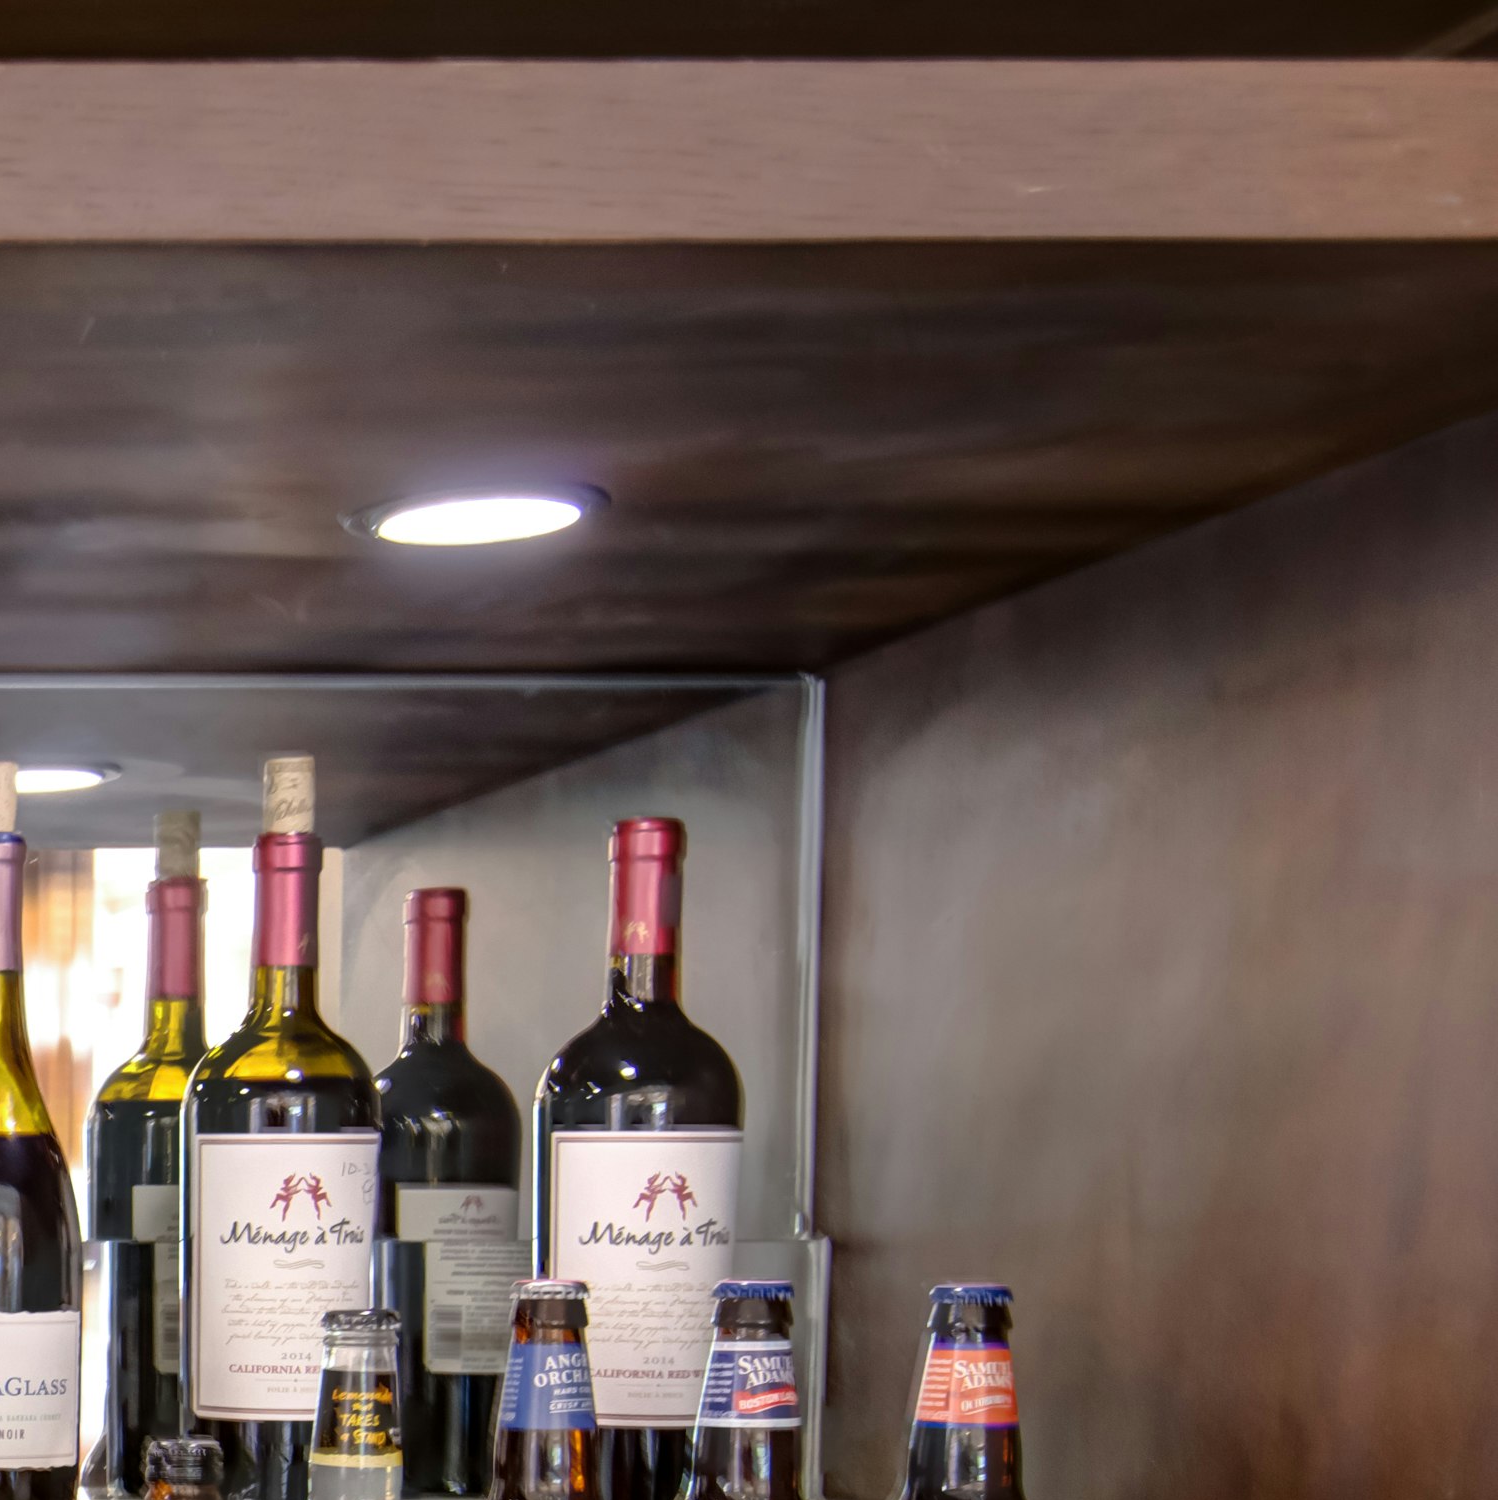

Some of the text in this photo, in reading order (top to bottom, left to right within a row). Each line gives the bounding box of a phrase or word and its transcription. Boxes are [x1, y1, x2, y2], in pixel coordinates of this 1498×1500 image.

[220, 1220, 365, 1253] Ménage à Trois
[578, 1220, 730, 1254] Ménage à Trois
[643, 1357, 674, 1365] 2014
[229, 1364, 301, 1374] CALIFORNIA
[667, 1370, 690, 1379] RED
[340, 1414, 380, 1426] TAKES
